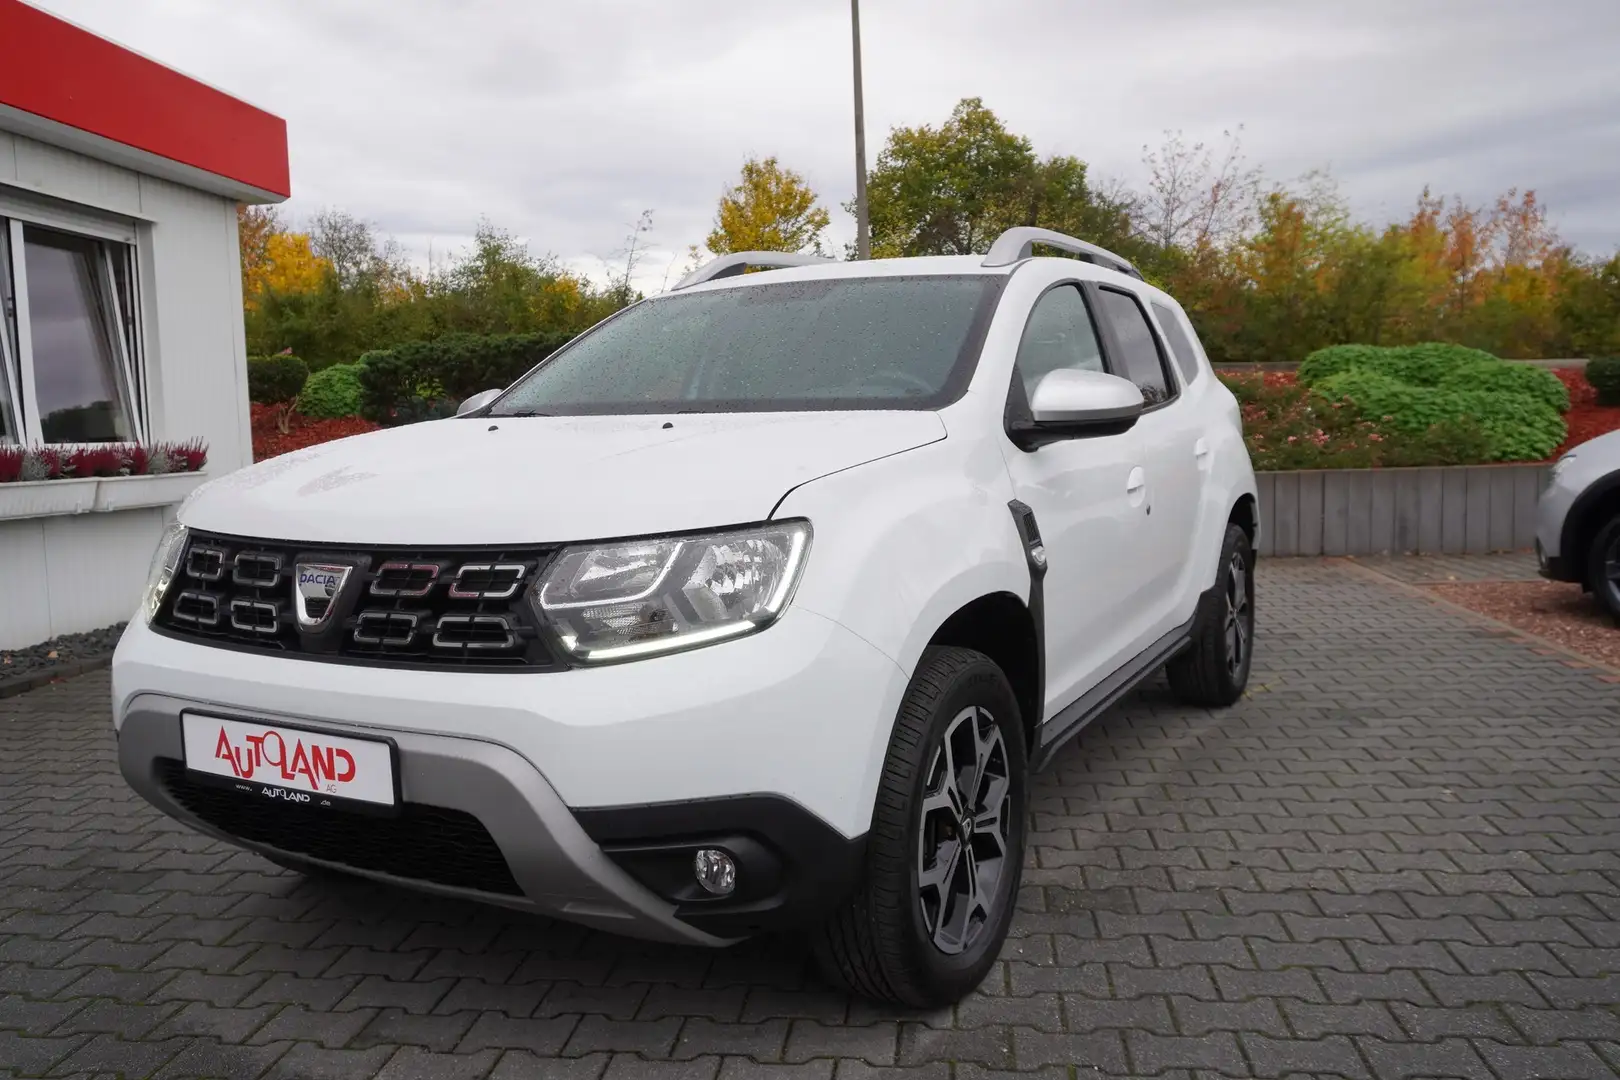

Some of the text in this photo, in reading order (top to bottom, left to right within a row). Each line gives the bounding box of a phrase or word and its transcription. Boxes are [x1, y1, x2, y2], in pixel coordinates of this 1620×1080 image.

[300, 573, 336, 585] DACIA
[215, 726, 356, 790] AUTOLAND
[261, 786, 311, 803] AUTOLAND
[326, 783, 337, 794] AG
